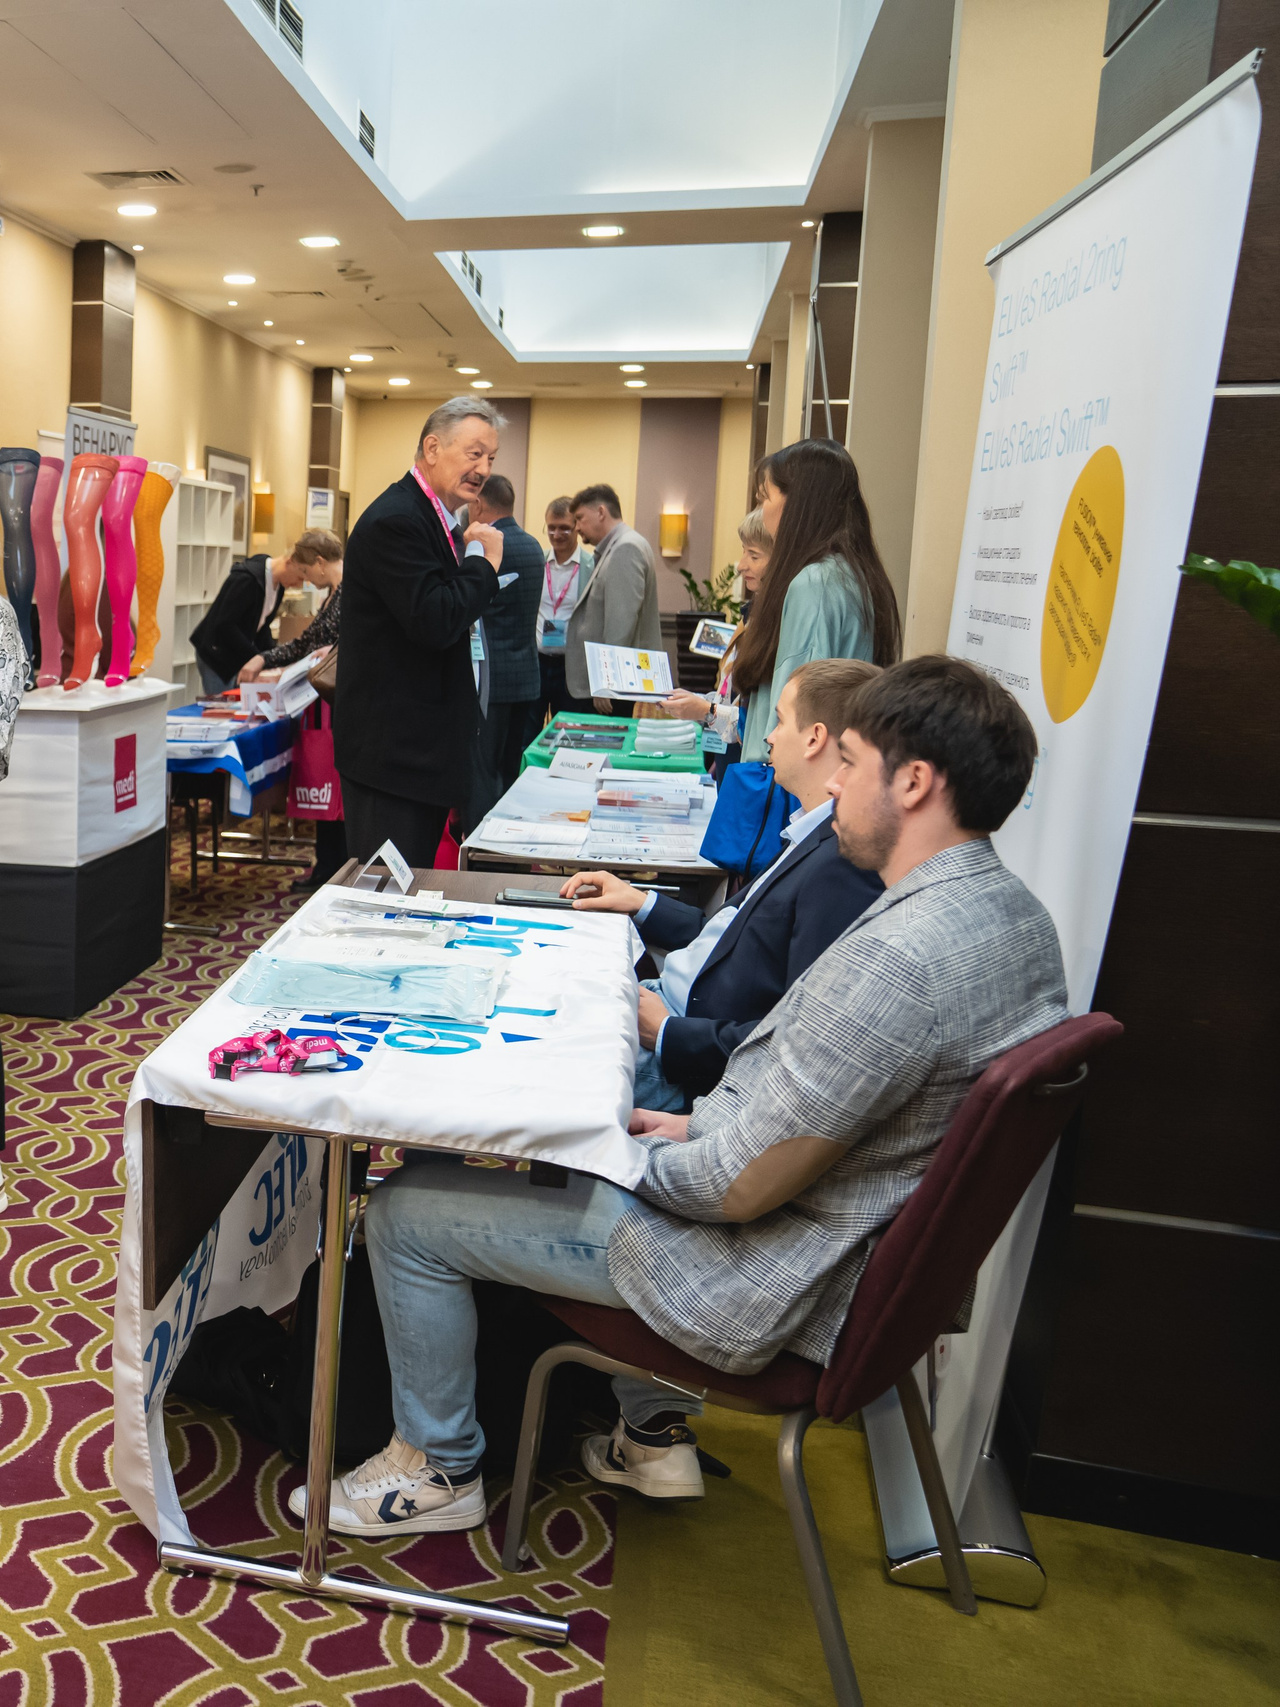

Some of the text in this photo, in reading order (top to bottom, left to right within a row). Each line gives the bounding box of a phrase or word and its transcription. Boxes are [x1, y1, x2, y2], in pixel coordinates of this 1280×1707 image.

[997, 234, 1128, 338] ELVeS Radial 2ring
[980, 424, 1017, 472] ELVeS
[1015, 411, 1057, 465] Radial
[116, 770, 135, 791] medi
[296, 782, 332, 804] medi
